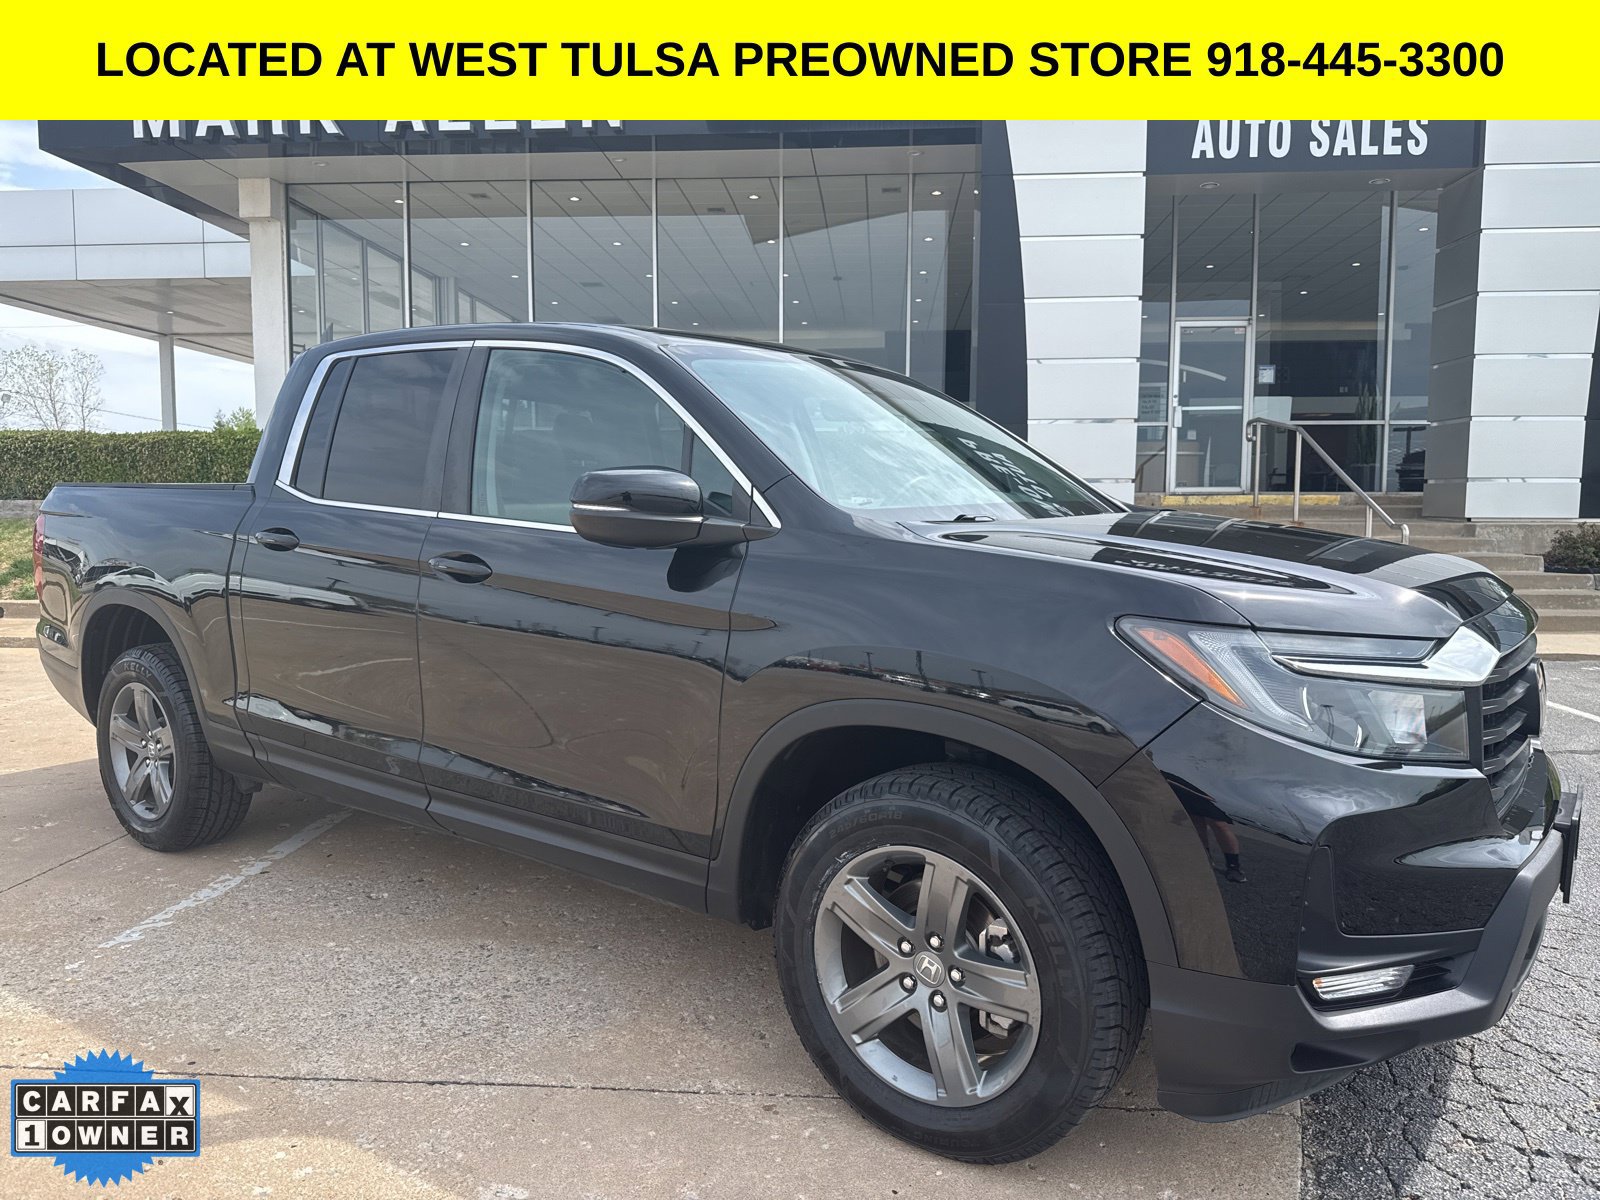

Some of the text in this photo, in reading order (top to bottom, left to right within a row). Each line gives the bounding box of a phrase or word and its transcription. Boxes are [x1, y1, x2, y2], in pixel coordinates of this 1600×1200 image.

[1191, 120, 1429, 159] AUTO SALES
[123, 661, 152, 679] KELLY
[1023, 896, 1079, 1008] KELLY
